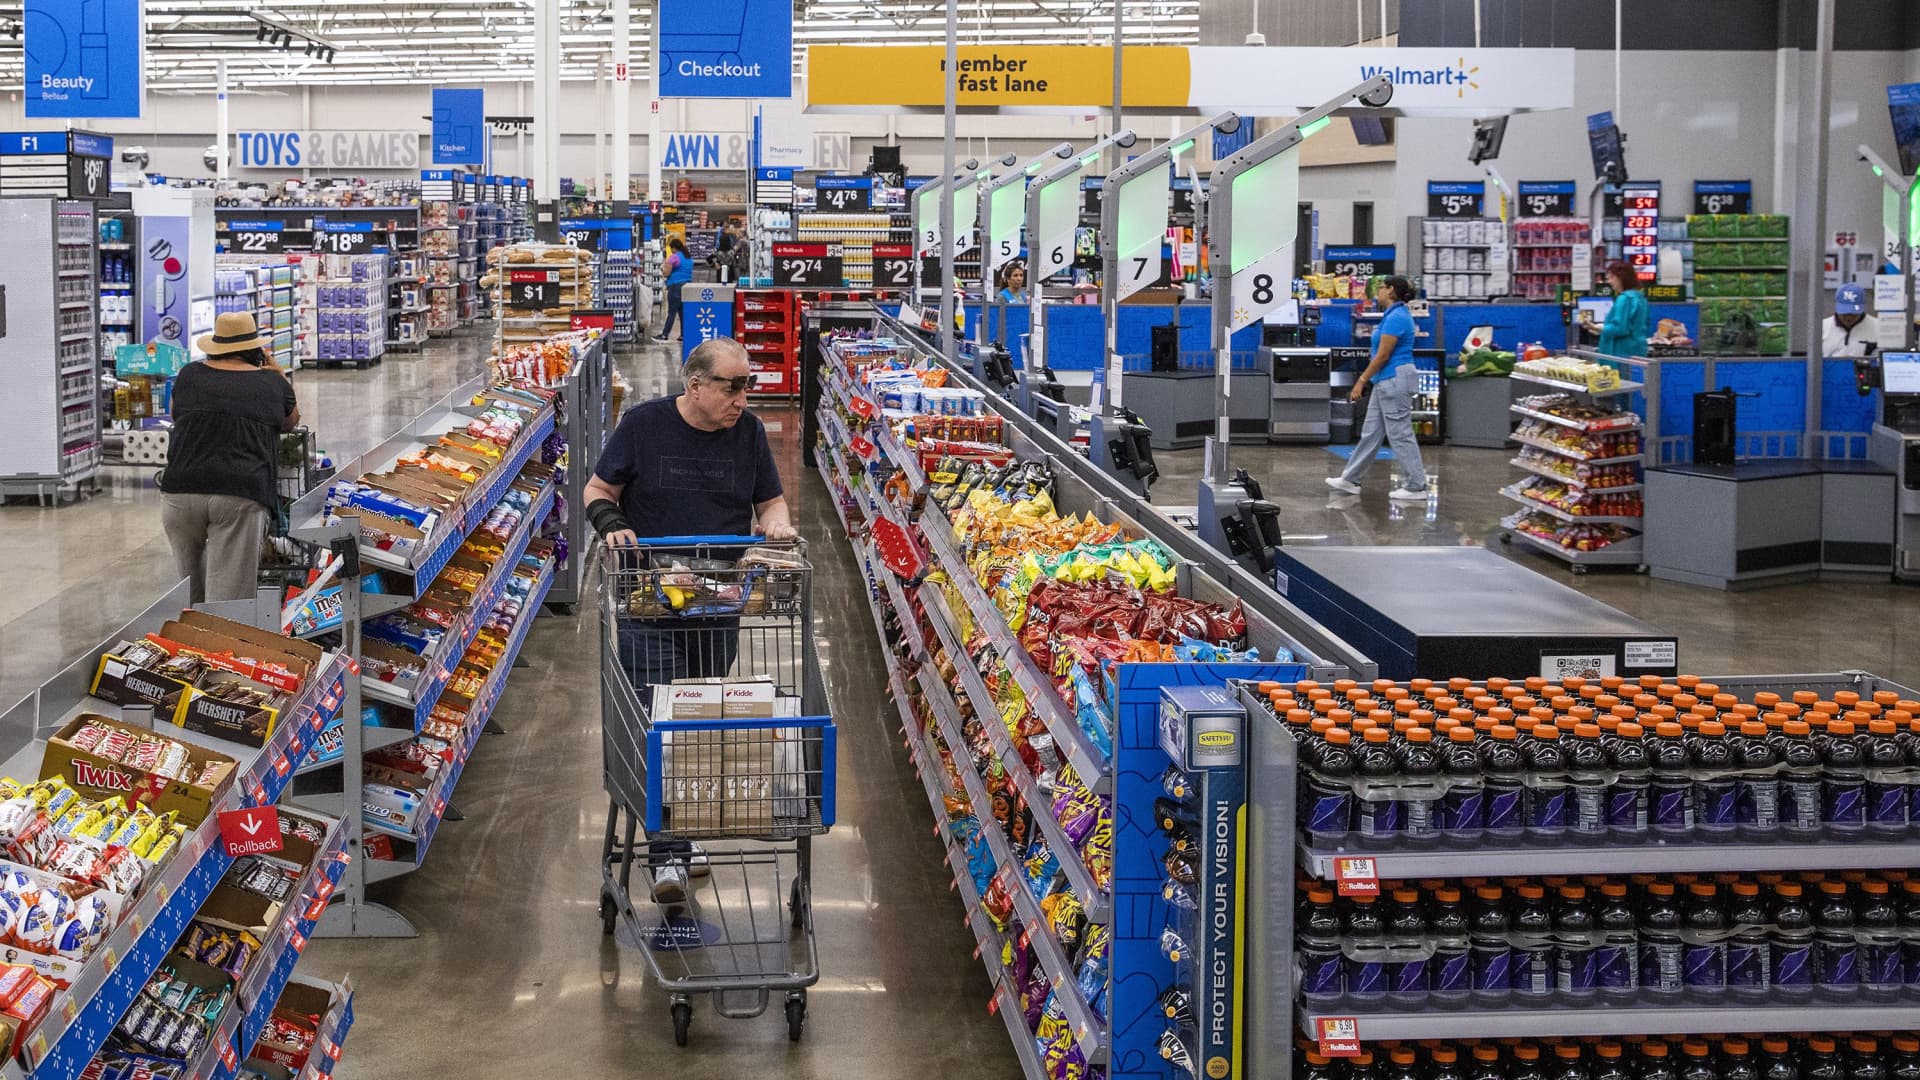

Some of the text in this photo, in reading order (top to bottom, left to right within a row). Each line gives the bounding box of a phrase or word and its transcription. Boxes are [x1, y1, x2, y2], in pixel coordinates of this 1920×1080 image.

[678, 60, 760, 77] Checkout
[42, 74, 94, 92] Beauty
[958, 74, 1048, 92] fast lane
[21, 137, 38, 151] F1
[239, 132, 417, 167] TOYS & GAMES
[439, 144, 466, 152] Kitchen
[661, 134, 719, 168] AWN
[727, 134, 745, 168] &
[769, 146, 802, 155] Pharmacy
[766, 170, 778, 179] G1
[825, 190, 858, 209] $476
[1441, 195, 1474, 214] $554
[1636, 198, 1653, 208] 54
[1628, 217, 1652, 228] 203
[237, 232, 278, 251] $2296
[927, 231, 934, 243] 3
[956, 236, 966, 248] 4
[1631, 236, 1651, 246] 150
[1001, 241, 1011, 256] 5
[1051, 246, 1064, 265] 6
[1635, 254, 1651, 265] 27
[782, 260, 823, 283] $274
[1133, 257, 1148, 281] 7
[524, 284, 544, 300] $1
[1252, 274, 1274, 305] 8
[1648, 287, 1680, 297] HERE
[351, 503, 381, 518] Almond
[125, 676, 166, 700] HERSHEY'S
[197, 700, 246, 724] HERSHEY'S
[172, 784, 189, 797] 24
[229, 837, 279, 855] Rollback
[1353, 859, 1368, 870] 6.98
[1348, 882, 1377, 890] Rollback
[1212, 800, 1229, 1045] PROTECT YOUR VISION!
[272, 1051, 294, 1064] SHARE
